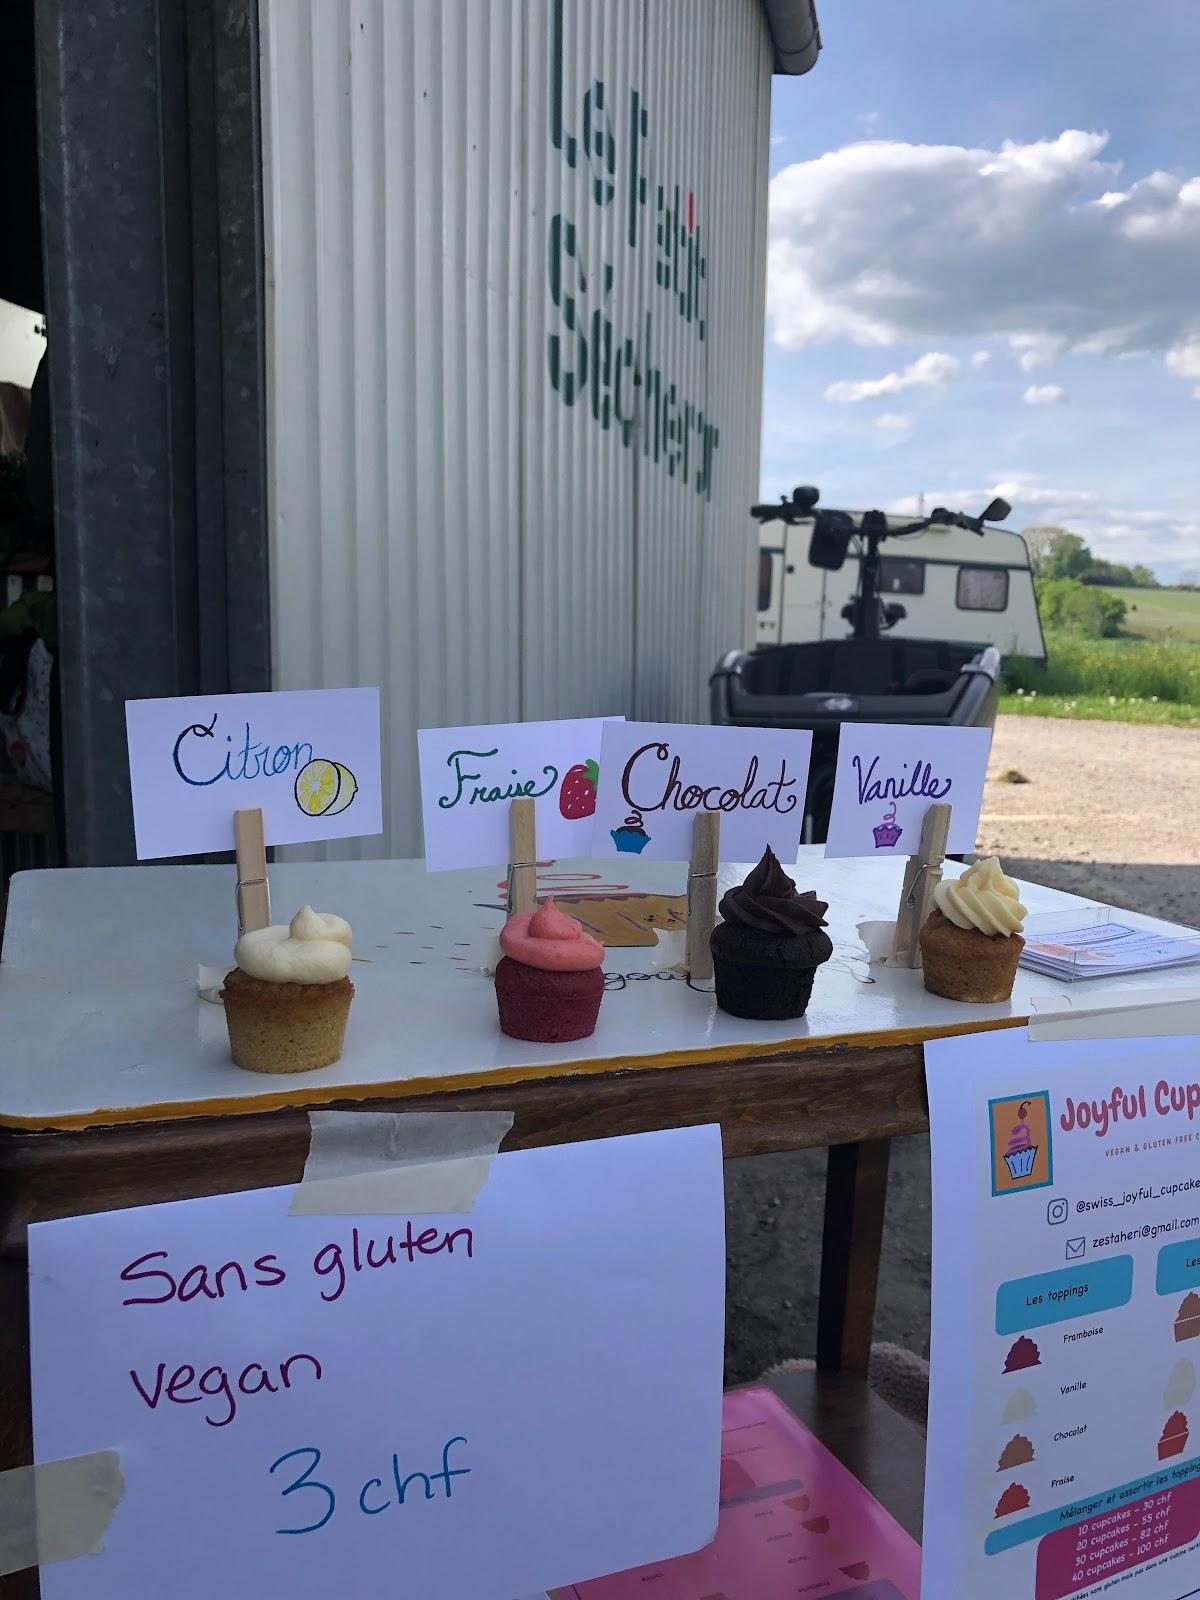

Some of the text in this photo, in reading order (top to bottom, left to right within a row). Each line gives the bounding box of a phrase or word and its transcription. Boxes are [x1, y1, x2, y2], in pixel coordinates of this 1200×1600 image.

[172, 712, 314, 787] Citron
[438, 748, 559, 809] Fraise
[621, 742, 797, 814] Chocolat
[851, 754, 953, 806] Vanille
[1060, 1079, 1200, 1138] Joyful Cup
[1105, 1145, 1131, 1157] VEGAN
[1134, 1144, 1139, 1152] &
[1143, 1138, 1172, 1150] GLUTEN
[1175, 1133, 1192, 1144] FREE
[1092, 1217, 1200, 1248] zestaheri@gmail.com
[120, 1219, 475, 1306] Sans gluten
[1026, 1283, 1089, 1306] Les toppings
[1063, 1326, 1104, 1343] Framboise
[129, 1353, 323, 1427] vegan
[1060, 1380, 1087, 1395] Vanille
[1053, 1424, 1087, 1442] Chocolat
[268, 1436, 473, 1536] 3 chf
[1051, 1474, 1075, 1488] Fraise
[1106, 1493, 1116, 1504] et
[1076, 1540, 1088, 1551] 20
[1090, 1524, 1130, 1545] cupcakes
[1141, 1513, 1153, 1525] 55
[1155, 1506, 1171, 1519] chf
[1078, 1524, 1089, 1536] 10
[1091, 1509, 1131, 1530] cupcakes
[1142, 1499, 1154, 1511] 30
[1156, 1491, 1172, 1505] chf
[1071, 1570, 1084, 1582] 40
[1086, 1554, 1126, 1576] cupcakes
[1137, 1542, 1152, 1555] 100
[1154, 1534, 1169, 1548] chf
[1074, 1555, 1086, 1567] 30
[1089, 1539, 1128, 1560] cupcakes
[1140, 1528, 1151, 1540] 82
[1154, 1520, 1169, 1534] chf
